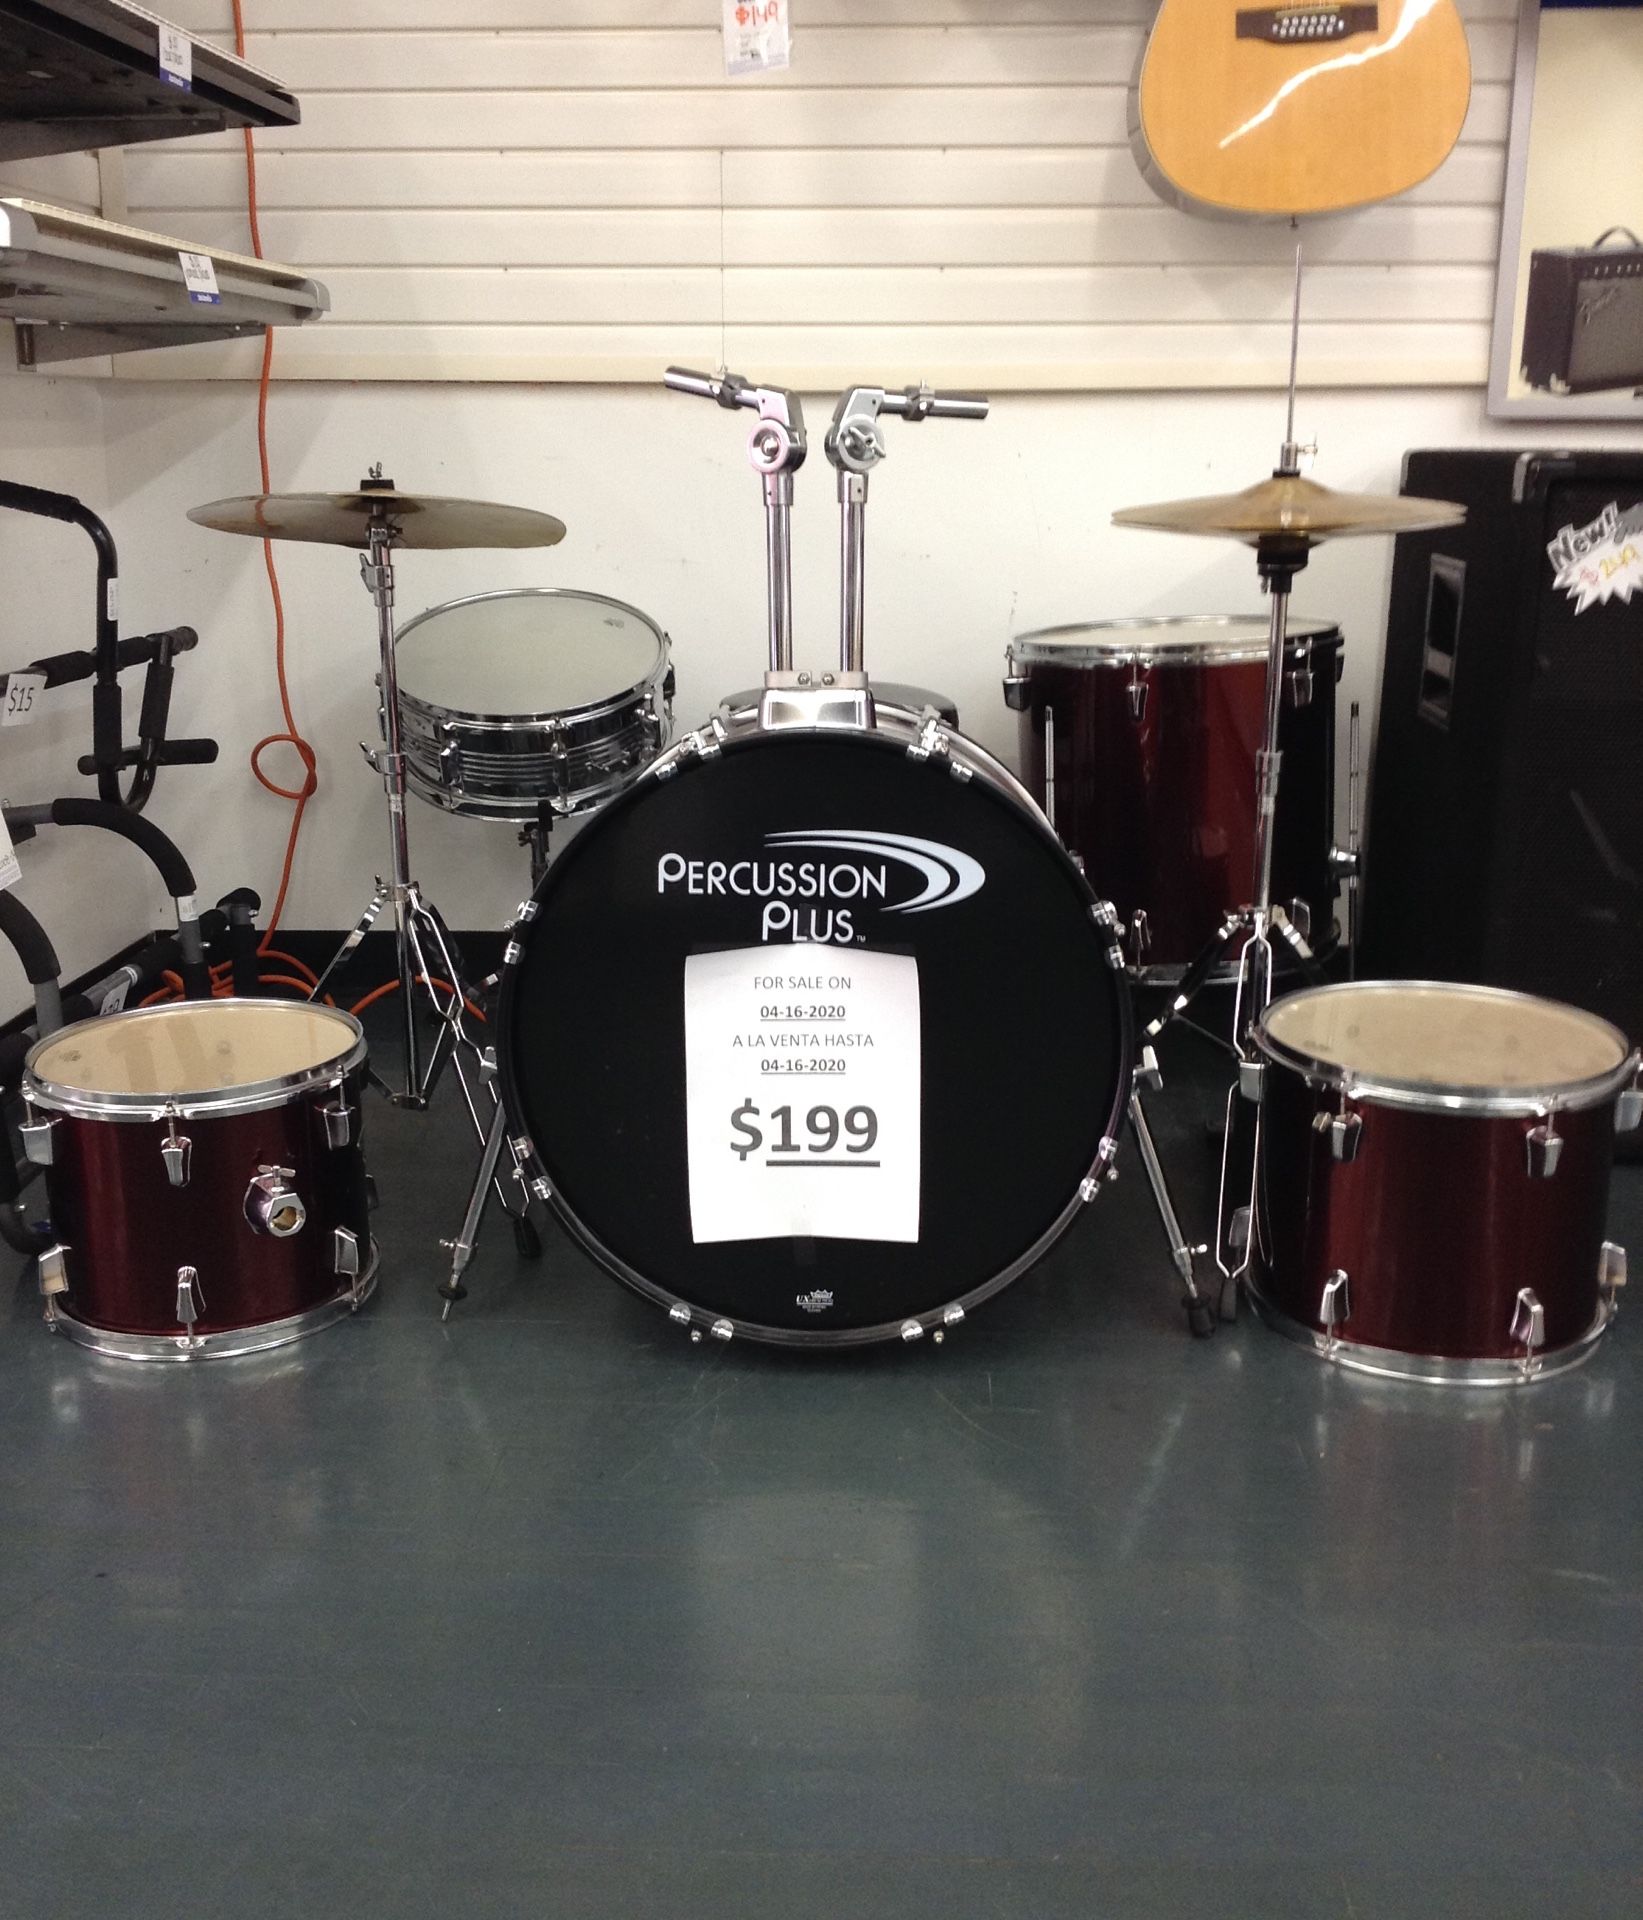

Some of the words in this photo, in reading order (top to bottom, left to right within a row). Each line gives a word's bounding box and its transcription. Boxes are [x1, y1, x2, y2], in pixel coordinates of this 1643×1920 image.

[8, 683, 35, 716] $15
[657, 852, 887, 899] PERCUSSION
[762, 900, 854, 943] PLUS
[754, 976, 783, 989] FOR
[788, 976, 823, 989] SALE
[828, 976, 852, 989] ON
[760, 1005, 846, 1019] 04-16-2020
[732, 1034, 743, 1047] A
[747, 1034, 766, 1047] LA
[769, 1034, 820, 1047] VENTA
[825, 1034, 874, 1047] HASTA
[760, 1058, 846, 1072] 04-16-2020
[730, 1097, 879, 1161] $199
